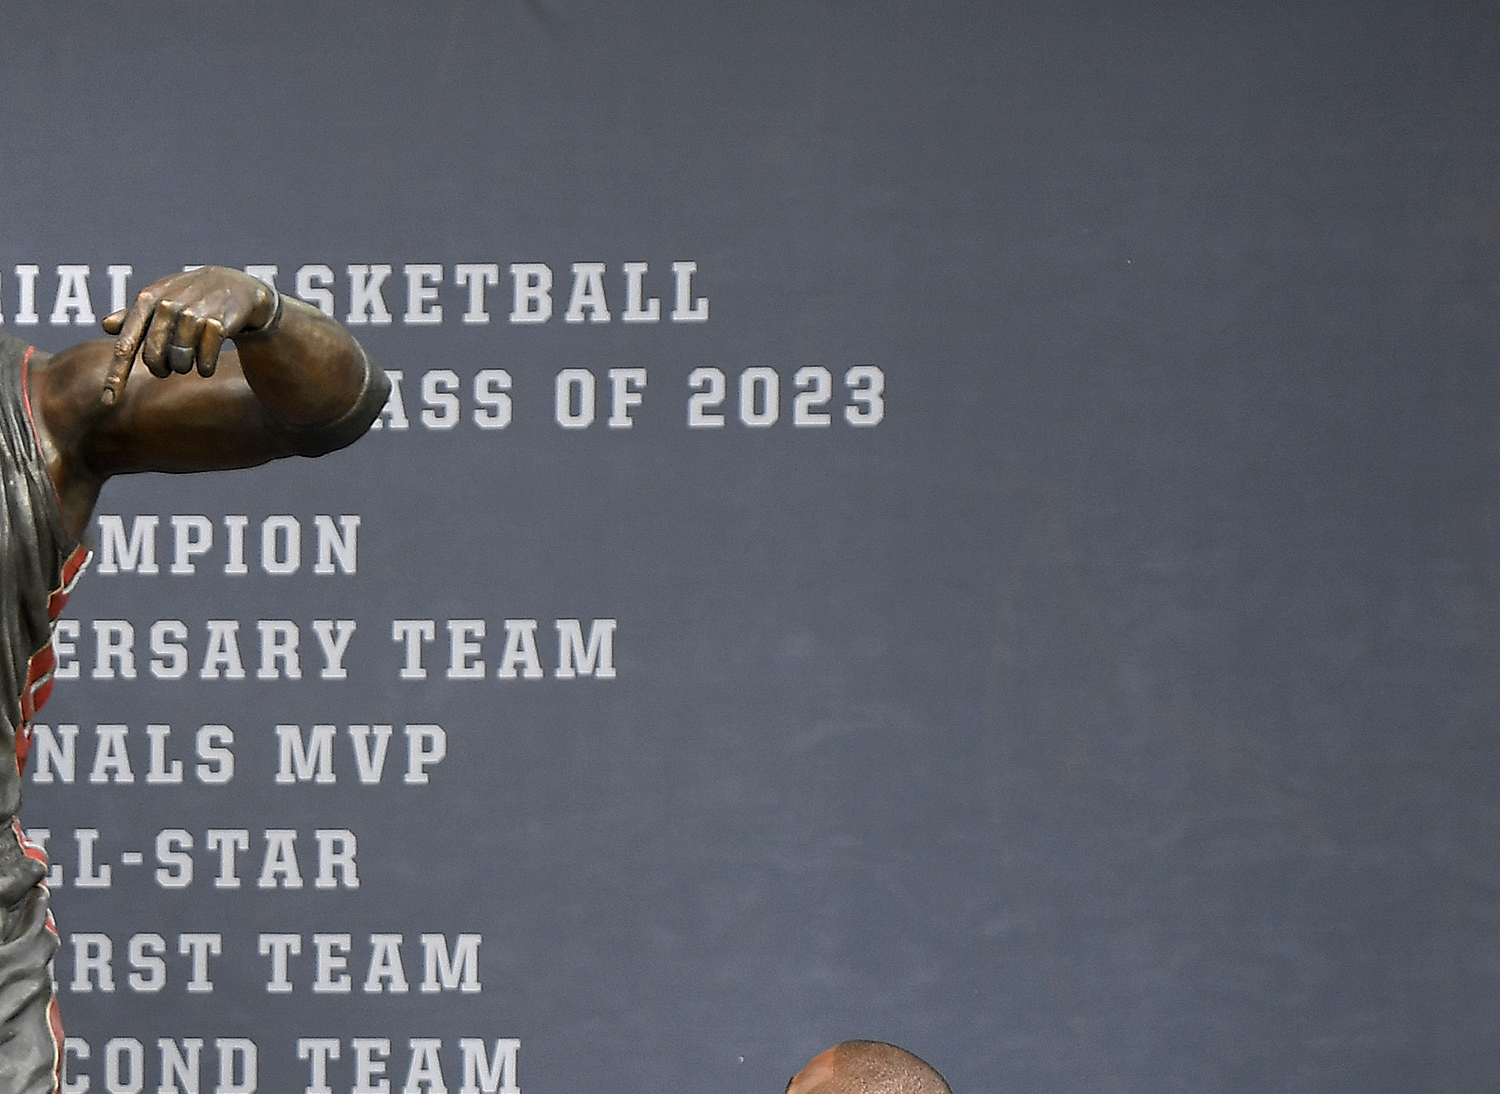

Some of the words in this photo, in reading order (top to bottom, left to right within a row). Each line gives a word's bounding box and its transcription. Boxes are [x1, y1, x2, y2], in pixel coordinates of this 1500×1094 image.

[183, 261, 710, 327] SKETBALL
[554, 368, 648, 430] OF
[687, 365, 886, 429] 2023
[96, 514, 363, 577] MPION
[51, 619, 358, 681] ERSARY
[391, 618, 618, 681] TEAM
[31, 724, 236, 785] NALS
[274, 724, 448, 786] MVP
[50, 933, 223, 994] RST
[258, 933, 484, 995] TEAM
